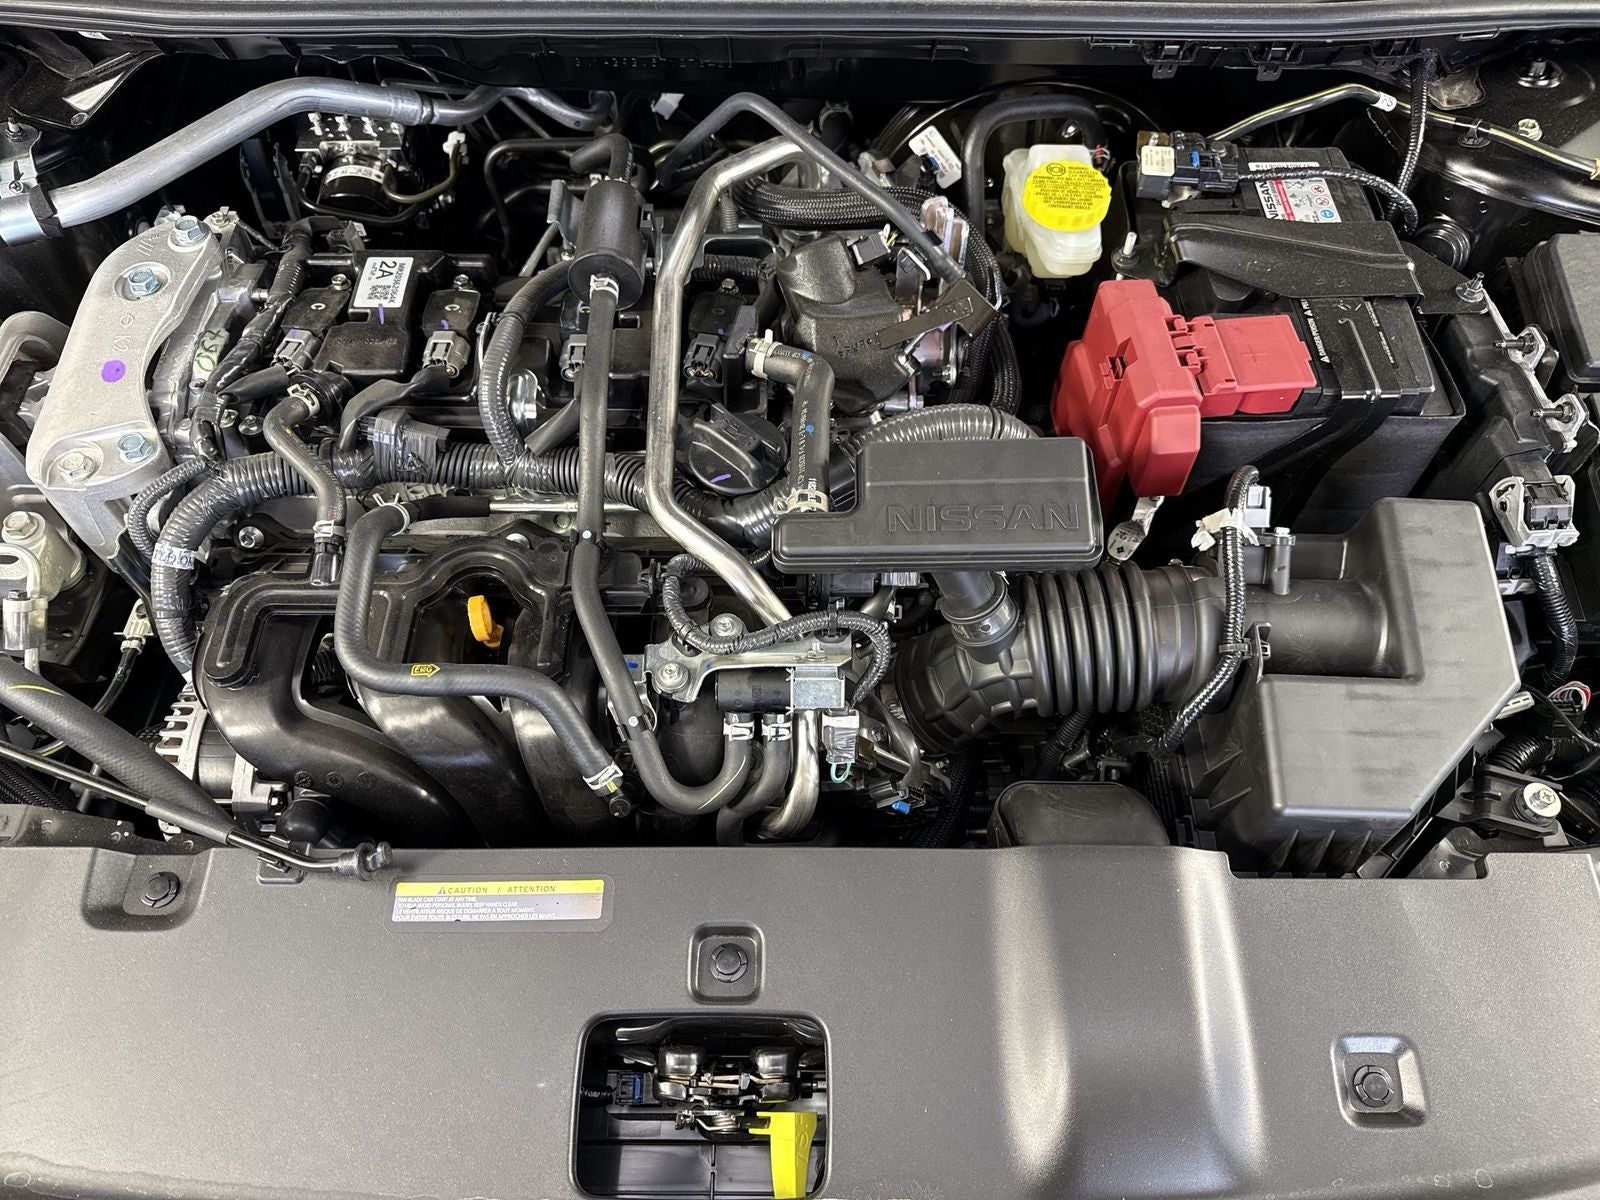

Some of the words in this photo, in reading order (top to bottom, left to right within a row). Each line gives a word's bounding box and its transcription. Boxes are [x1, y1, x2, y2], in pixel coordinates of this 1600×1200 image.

[1260, 180, 1278, 220] NISSAN
[376, 261, 397, 280] 2A
[888, 504, 1080, 532] NISSAN
